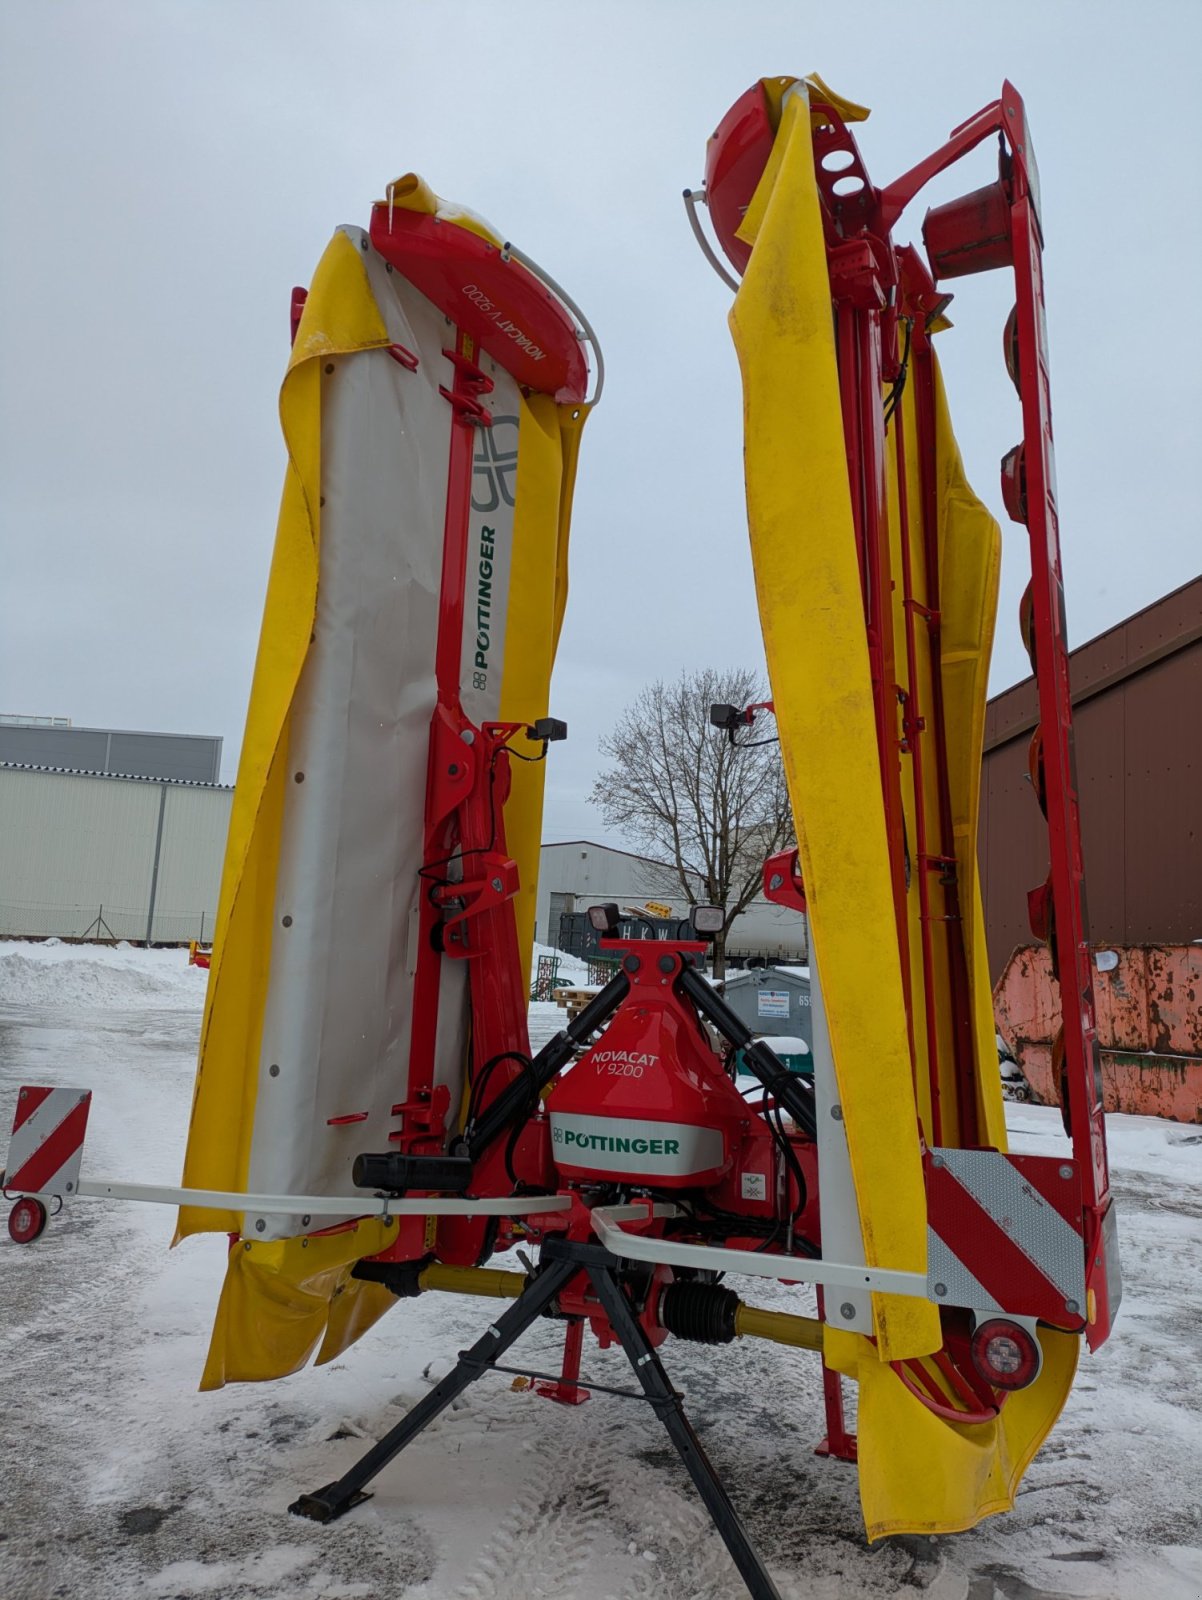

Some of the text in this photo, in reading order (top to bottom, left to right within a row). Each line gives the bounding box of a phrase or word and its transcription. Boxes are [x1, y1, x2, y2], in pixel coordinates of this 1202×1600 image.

[462, 284, 495, 311] 9200
[487, 311, 502, 320] V
[496, 320, 546, 360] NOVACAT
[591, 1051, 659, 1066] NOVACAT
[596, 1063, 644, 1078] V 9200
